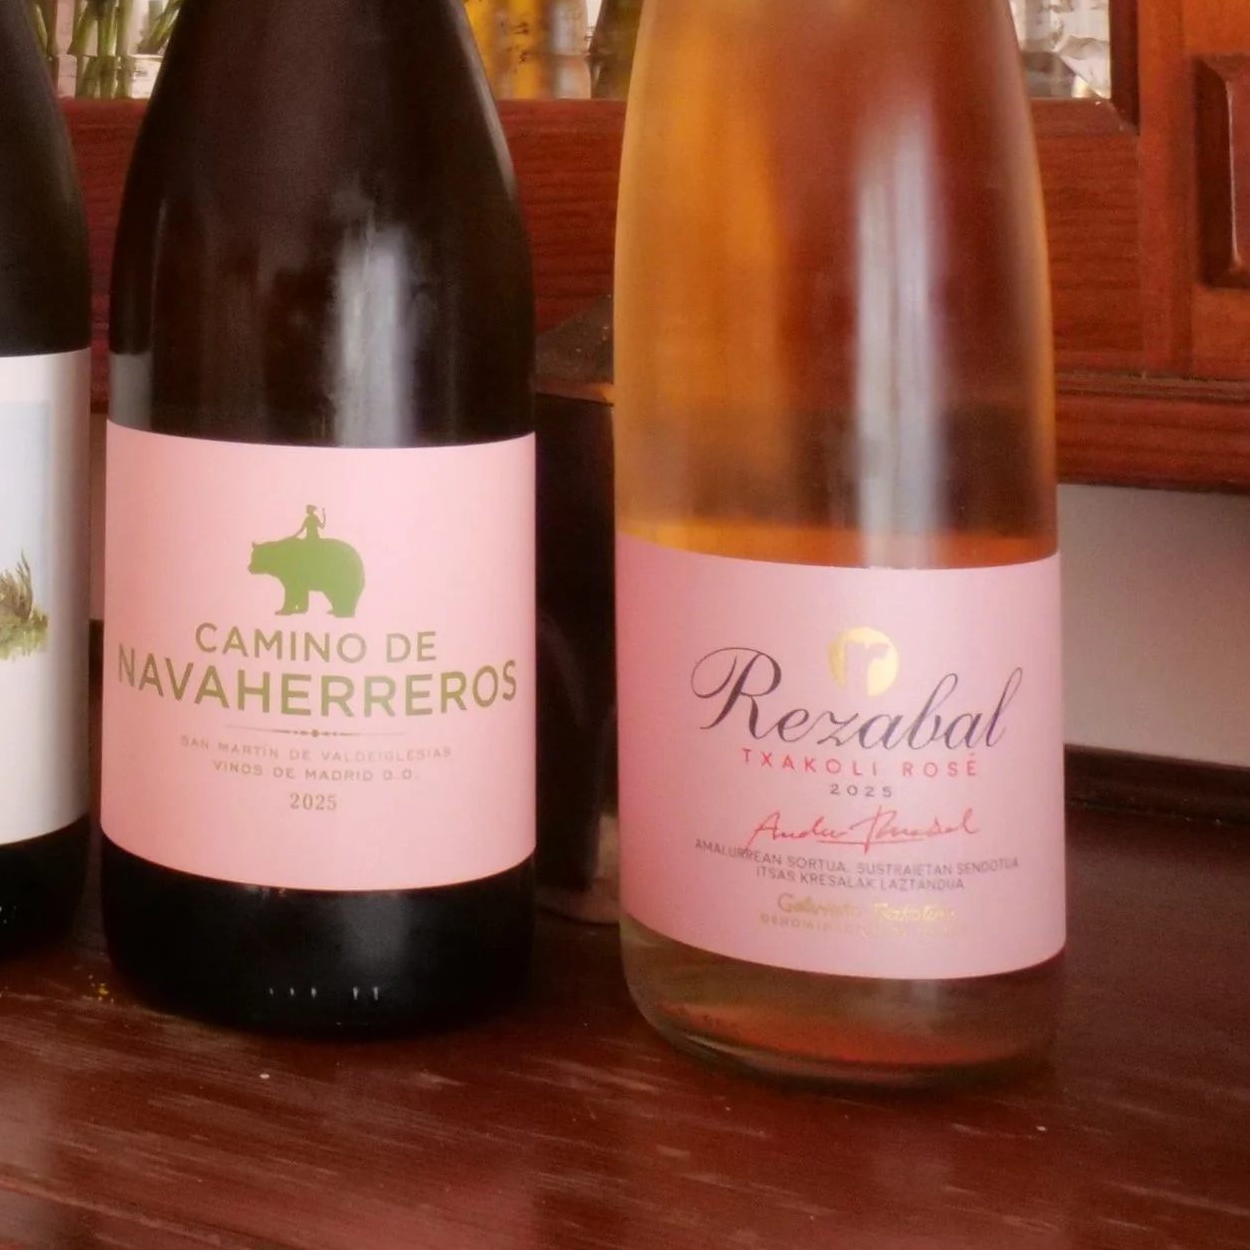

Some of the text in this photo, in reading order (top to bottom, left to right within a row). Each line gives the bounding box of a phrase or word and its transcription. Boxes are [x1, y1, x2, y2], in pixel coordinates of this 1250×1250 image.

[195, 622, 437, 664] CAMINO DE
[117, 643, 518, 718] NAVAHERREROS
[691, 646, 1023, 750] Rezabal
[180, 734, 209, 750] SAN
[289, 749, 311, 761] DE
[212, 759, 264, 776] VINOS
[273, 766, 296, 779] DE
[305, 769, 374, 782] MADRID
[743, 748, 977, 778] TXAKOLI ROSÉ
[289, 792, 338, 811] 2025
[830, 783, 893, 799] 2025
[756, 865, 796, 882] ITSAS
[880, 878, 966, 892] LAZTANDUA
